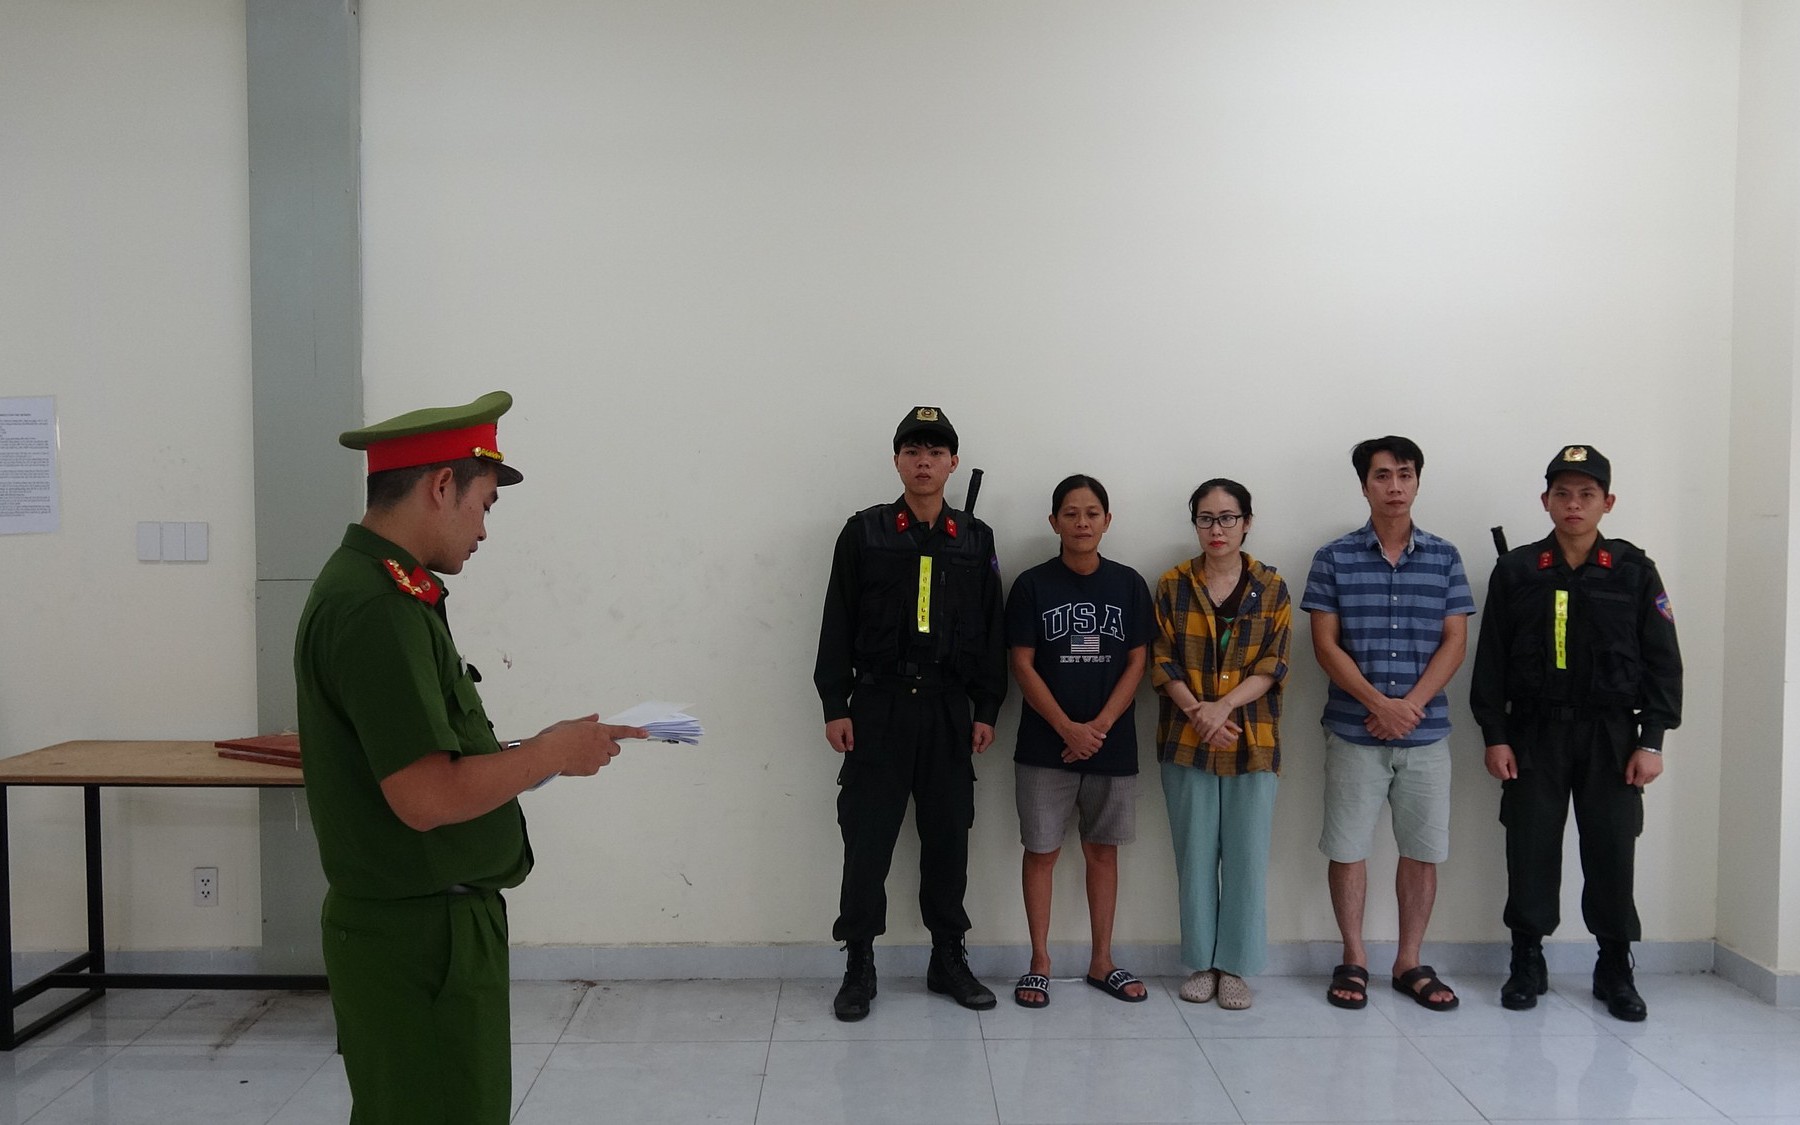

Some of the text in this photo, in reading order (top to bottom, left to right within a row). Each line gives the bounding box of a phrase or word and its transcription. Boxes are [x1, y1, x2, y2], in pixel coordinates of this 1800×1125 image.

[1042, 603, 1125, 641] USA
[1059, 655, 1112, 663] KEY WEST
